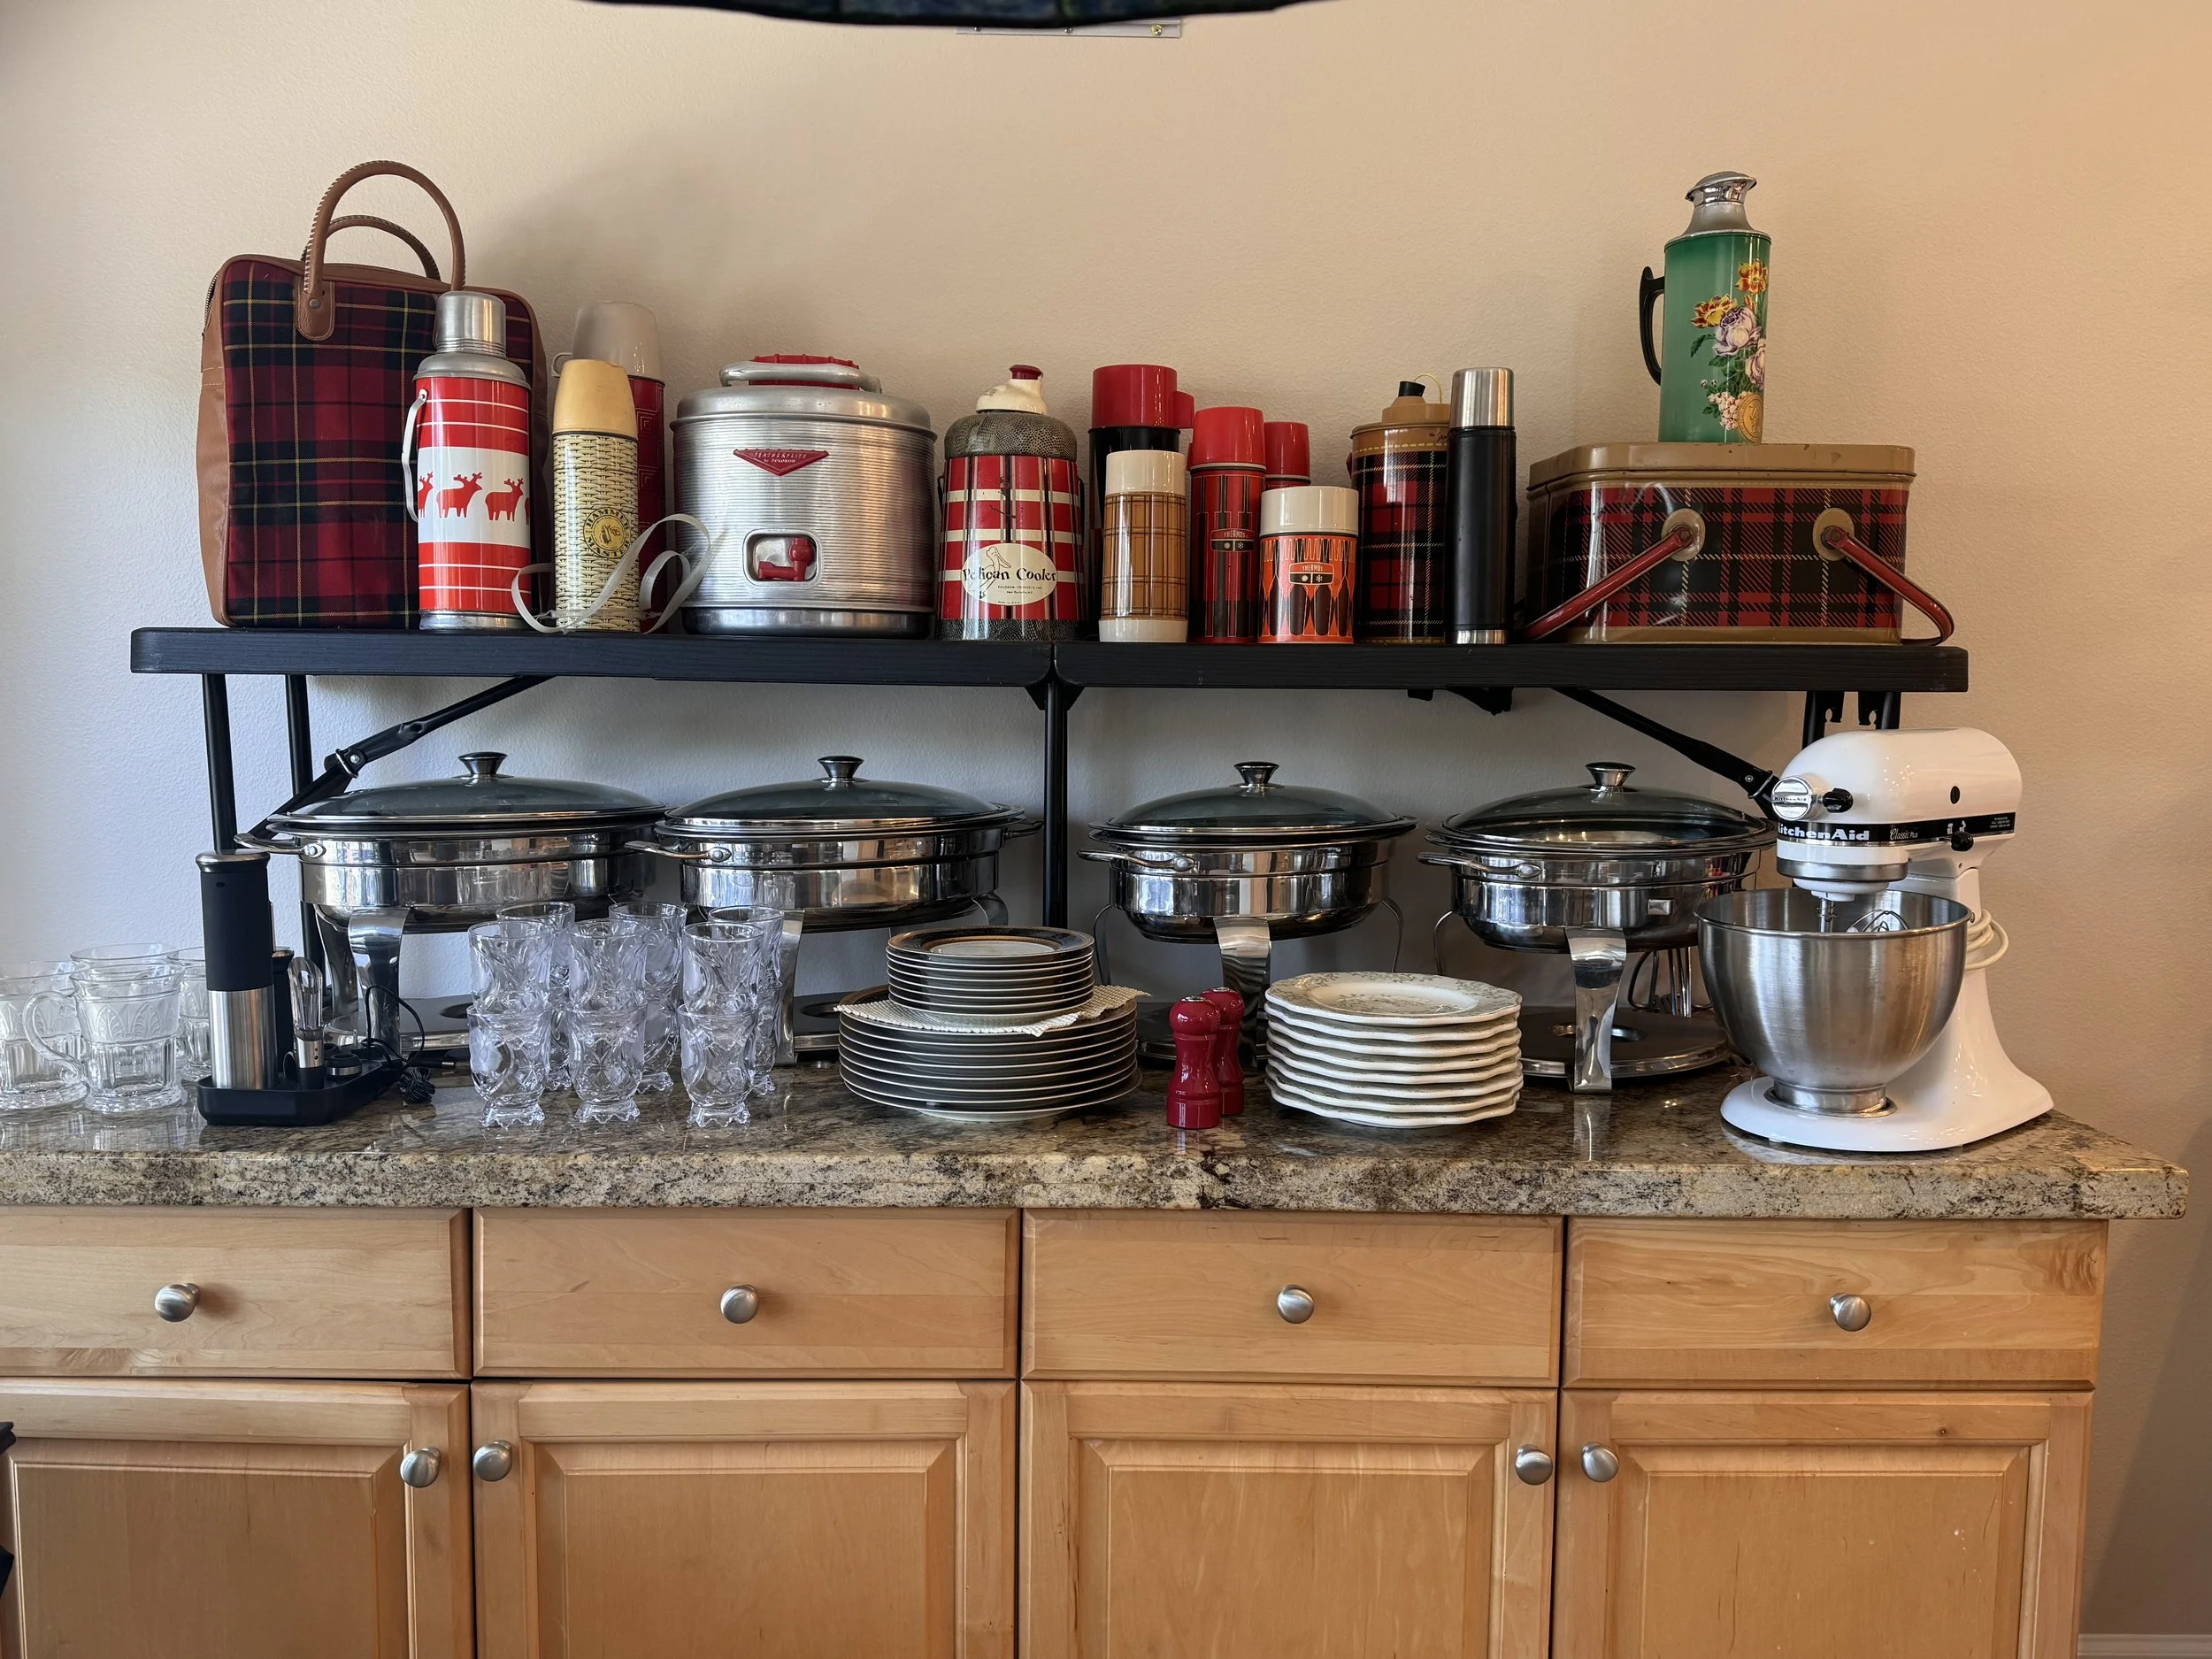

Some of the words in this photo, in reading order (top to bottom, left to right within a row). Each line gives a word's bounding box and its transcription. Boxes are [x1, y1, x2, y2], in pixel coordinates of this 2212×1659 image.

[586, 508, 629, 529] HAMMER
[1224, 529, 1246, 538] THERMOS
[585, 536, 629, 557] MASTER
[963, 566, 1010, 581] Pelican
[1016, 567, 1056, 581] Cooler
[1889, 828, 1909, 841] Classic
